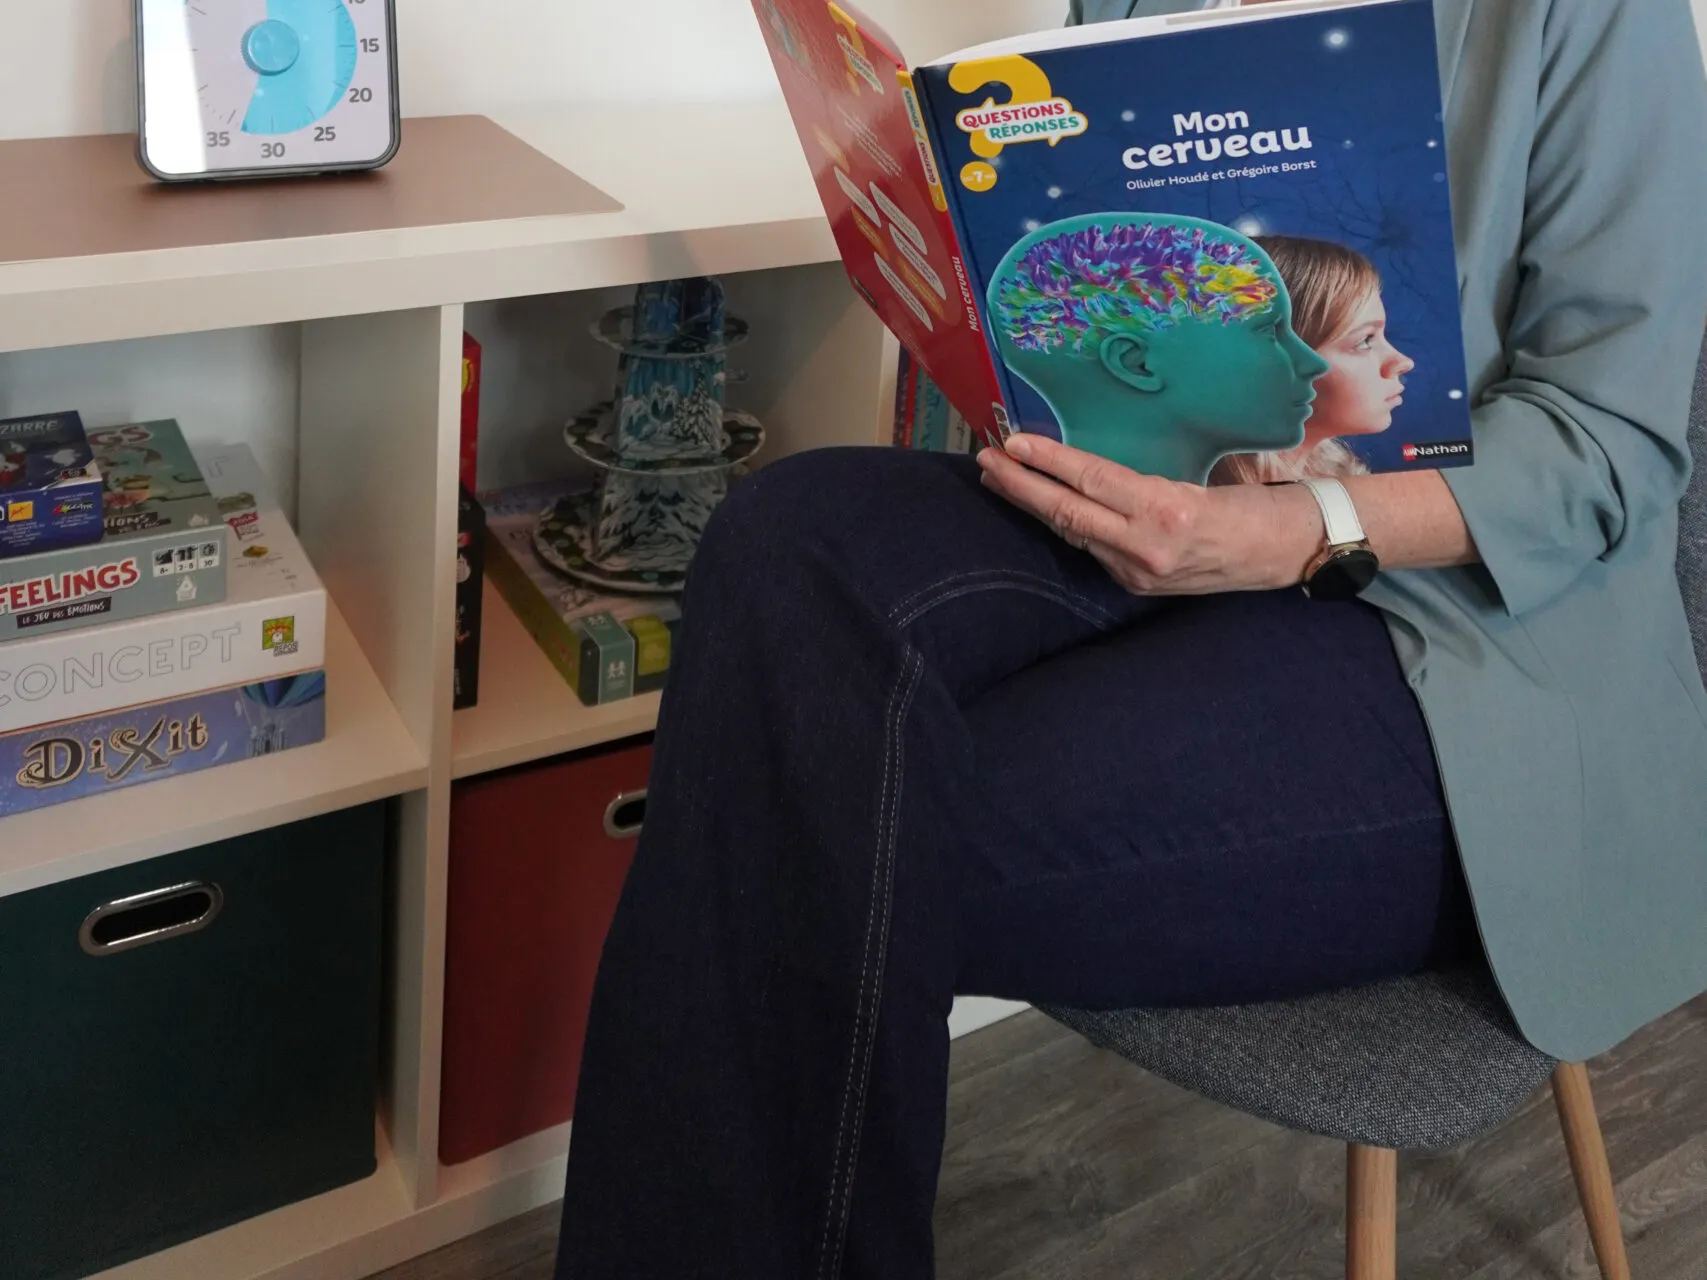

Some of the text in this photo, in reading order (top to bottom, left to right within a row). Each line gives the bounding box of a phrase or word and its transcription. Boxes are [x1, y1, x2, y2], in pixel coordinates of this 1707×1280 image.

[360, 38, 380, 53] 15
[349, 87, 373, 103] 20
[989, 116, 1079, 139] RÉPONSES
[1172, 110, 1249, 136] Mon
[207, 131, 230, 147] 35
[314, 126, 336, 141] 25
[261, 142, 285, 158] 30
[1121, 126, 1312, 170] cerveau
[973, 171, 984, 183] 7
[1126, 159, 1317, 190] Olivier Houdé et Grégoire Borst
[952, 256, 980, 332] Mon cerveau
[1411, 443, 1468, 456] Nathan
